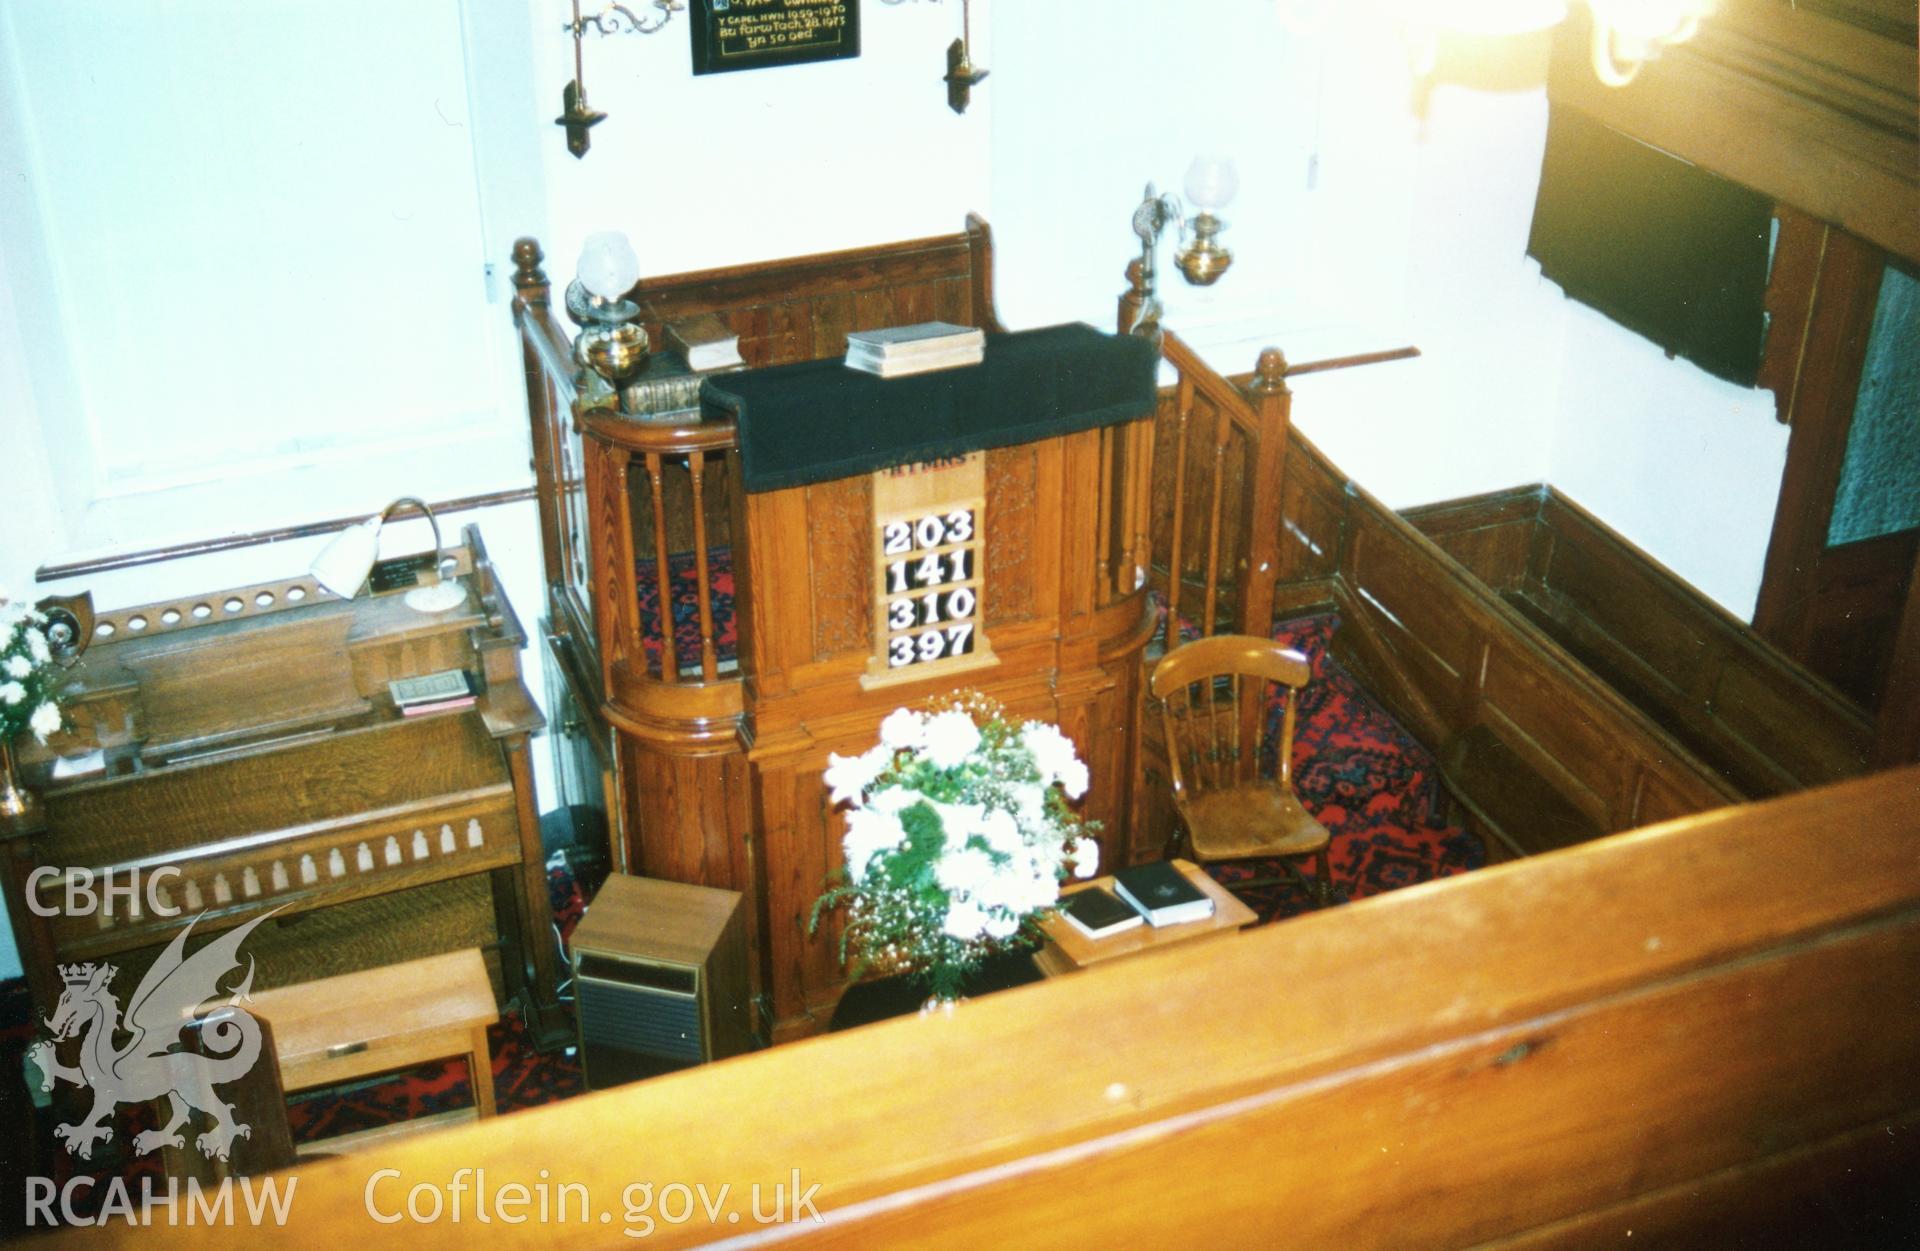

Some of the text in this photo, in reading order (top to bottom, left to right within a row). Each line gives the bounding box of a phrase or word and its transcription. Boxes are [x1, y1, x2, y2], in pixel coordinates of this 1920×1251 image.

[884, 509, 973, 556] 203
[888, 549, 967, 593] 141
[889, 587, 975, 631] 310
[889, 623, 973, 667] 397
